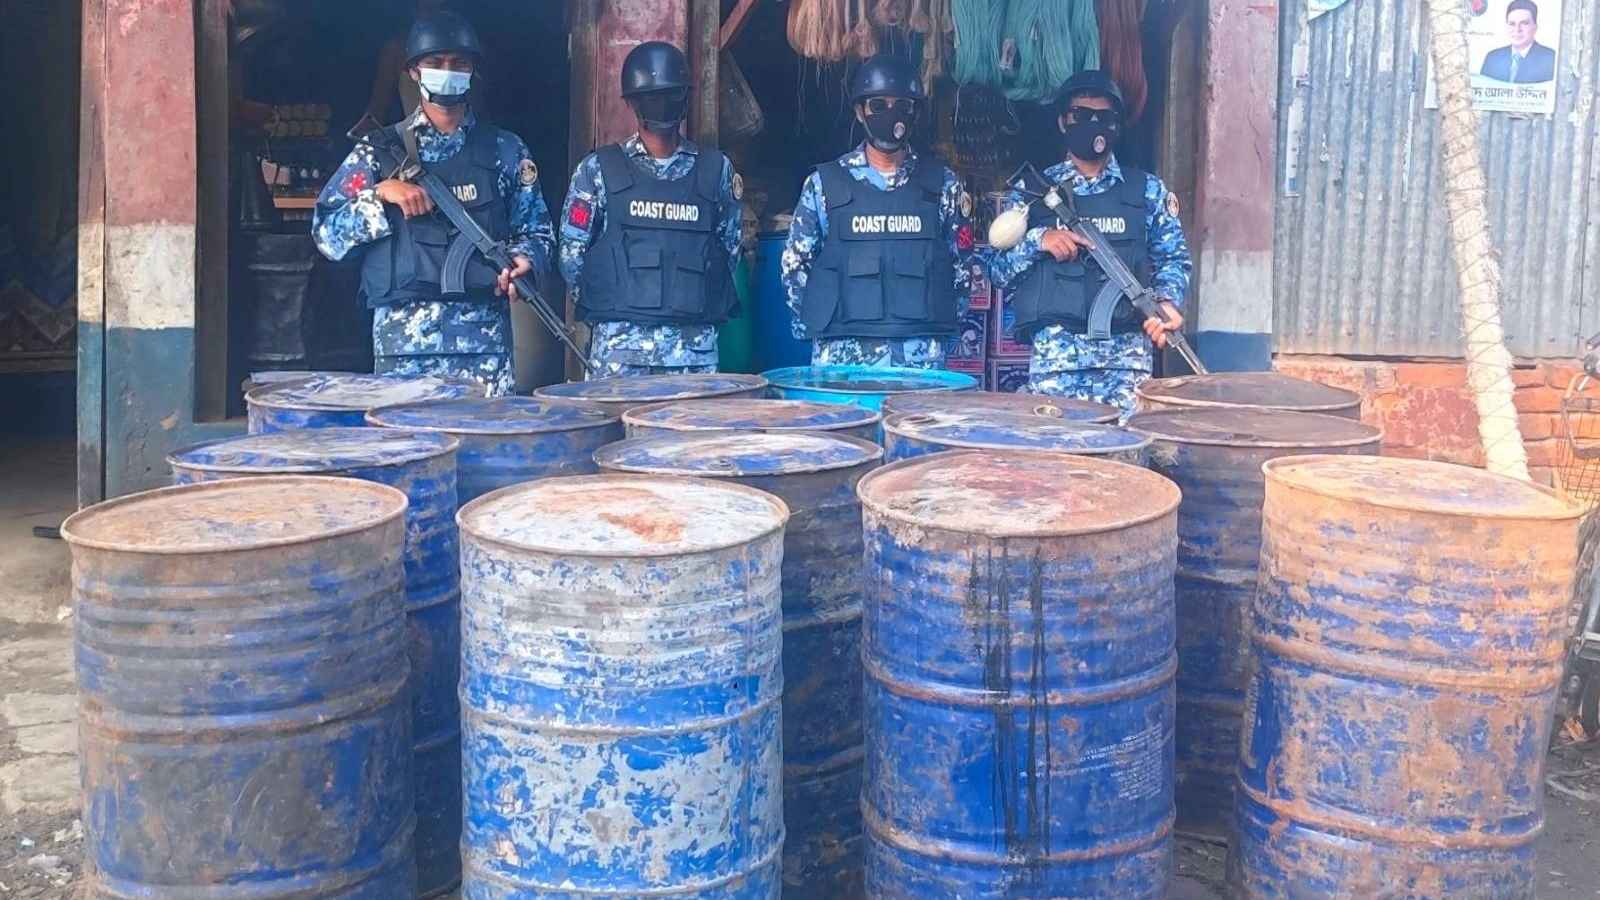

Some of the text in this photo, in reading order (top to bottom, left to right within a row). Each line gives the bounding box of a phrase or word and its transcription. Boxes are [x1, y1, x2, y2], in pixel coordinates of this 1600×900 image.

[453, 183, 477, 201] ARD
[630, 200, 699, 221] COAST GUARD
[852, 215, 921, 233] COAST GUARD
